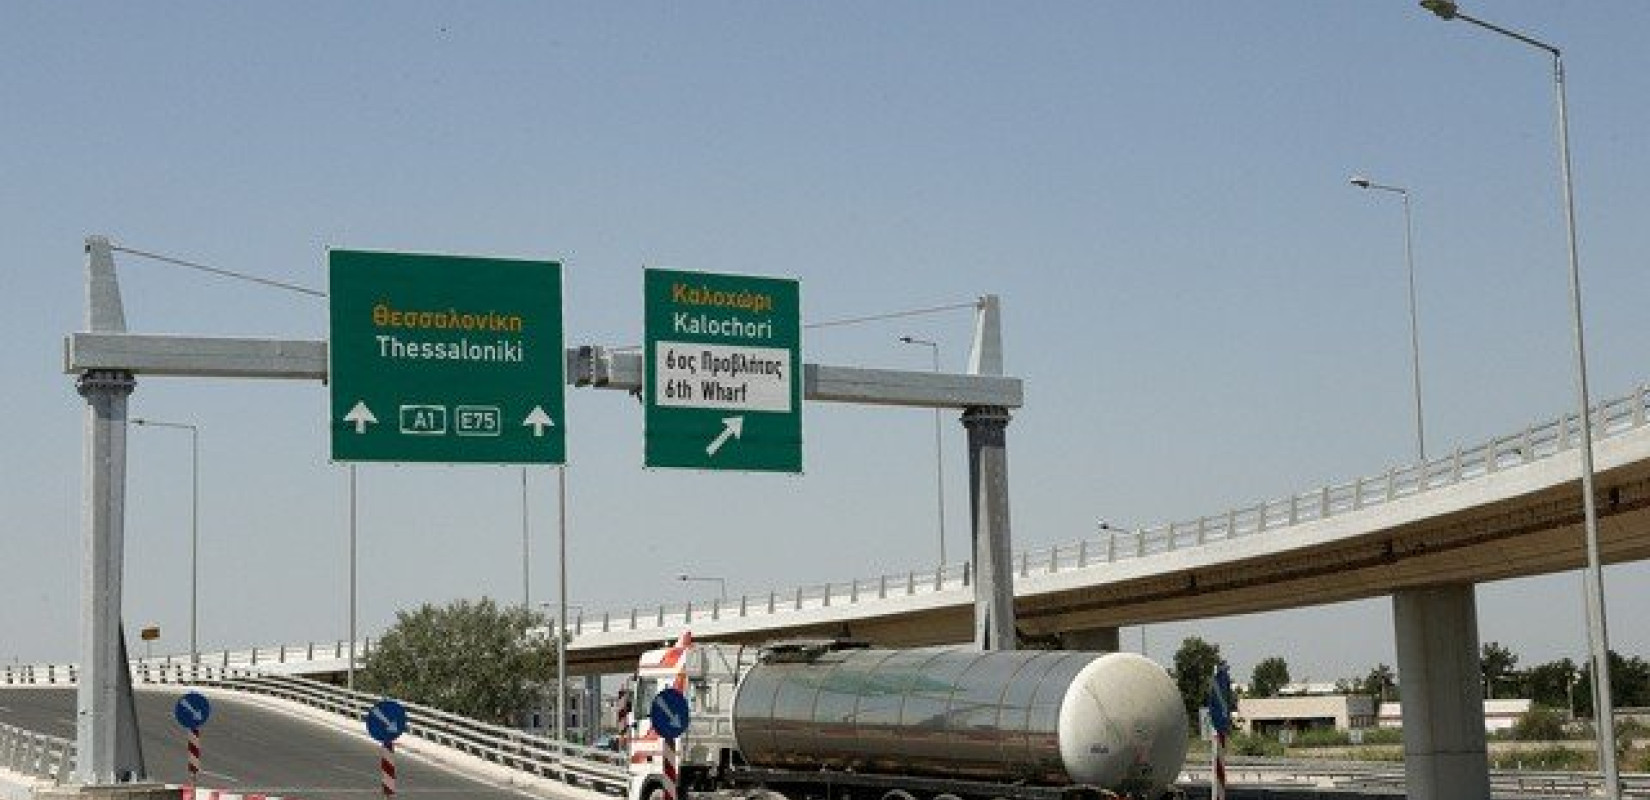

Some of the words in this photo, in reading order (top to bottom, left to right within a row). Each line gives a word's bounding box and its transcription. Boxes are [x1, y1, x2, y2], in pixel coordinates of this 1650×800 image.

[673, 283, 772, 313] Καλοχώρι
[373, 304, 522, 333] Θεσσαλονίκη
[674, 312, 772, 338] Kalochori
[376, 335, 523, 361] Thessaloniki
[701, 351, 783, 380] Προβλήτας
[665, 379, 692, 400] 6th
[701, 381, 747, 402] Wharf
[414, 411, 435, 429] A1
[460, 412, 496, 430] E75
